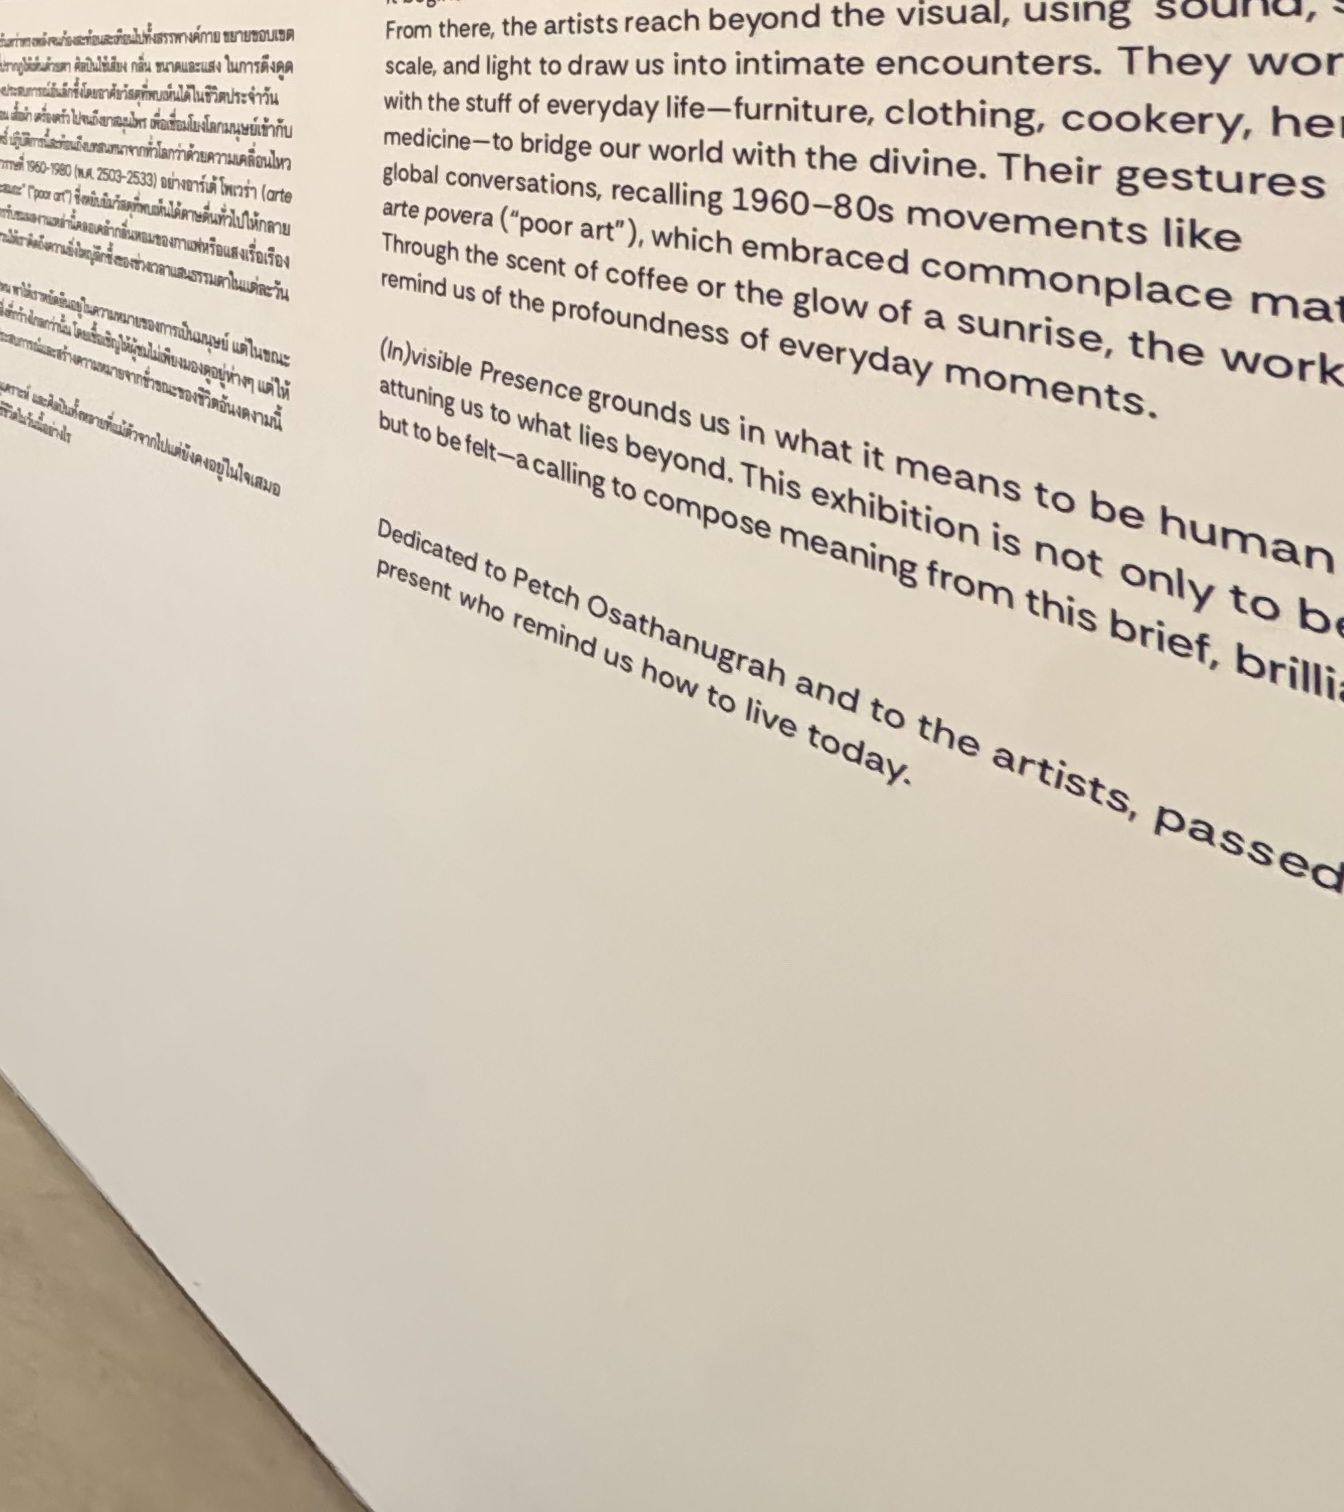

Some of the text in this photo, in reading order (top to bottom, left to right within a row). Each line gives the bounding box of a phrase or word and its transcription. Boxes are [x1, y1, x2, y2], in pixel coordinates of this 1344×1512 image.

[382, 161, 439, 187] global
[445, 170, 603, 202] conversations,
[611, 181, 724, 217] recalling
[906, 205, 1149, 246] movements
[1163, 216, 1243, 253] like
[520, 131, 593, 163] bridge
[599, 140, 642, 160] our
[647, 138, 724, 164] world
[731, 140, 796, 169] with
[804, 144, 858, 173] the
[869, 147, 987, 180] divine.
[996, 151, 1103, 186] Their
[1115, 164, 1326, 200] gestures
[382, 200, 420, 220] arte
[423, 205, 494, 228] povera
[650, 225, 733, 256] which
[741, 236, 910, 276] embraced
[920, 257, 1234, 312] commonplace
[381, 272, 1158, 420] remind us of the profoundness of everyday moments.
[380, 335, 1335, 575] (In)visible Presence grounds us in what it means to be human
[376, 558, 912, 787] present who remind us how to live today.
[377, 517, 1344, 895] Dedicated to Petch Osathanugrah and to the artists, passed
